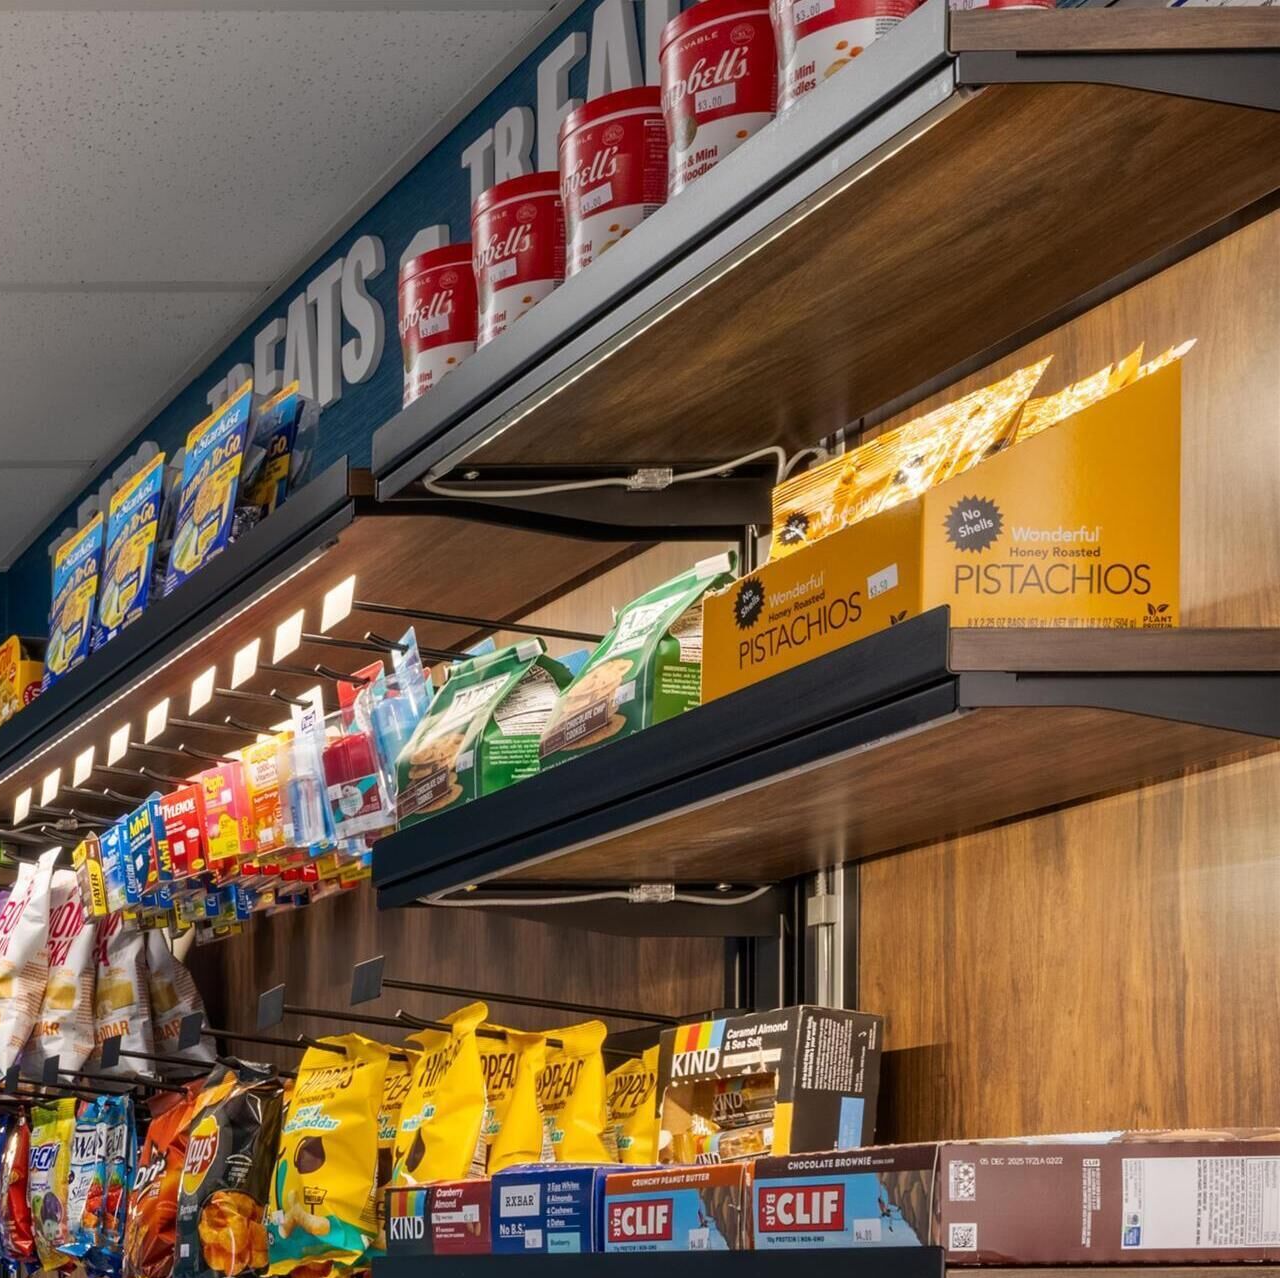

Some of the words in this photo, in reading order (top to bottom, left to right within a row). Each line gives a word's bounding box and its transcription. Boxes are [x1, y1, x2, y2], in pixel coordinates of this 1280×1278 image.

[795, 4, 821, 23] $3.00
[662, 46, 750, 116] mpbell's
[794, 61, 816, 81] Mini
[792, 78, 817, 97] dles
[462, 0, 672, 200] TREA
[697, 95, 722, 110] $3.00
[695, 146, 718, 164] Mini
[560, 146, 619, 201] mpbell's
[473, 223, 532, 277] pbell's
[399, 289, 454, 338] pbell's
[962, 509, 981, 522] No
[958, 518, 994, 538] Shells
[1011, 526, 1100, 542] Wonderful
[1009, 547, 1049, 560] Honey
[1053, 547, 1101, 558] Roasted
[769, 572, 824, 608] Wonderful
[954, 564, 1151, 594] PISTACHIOS
[740, 596, 761, 618] Shells
[742, 590, 753, 603] No
[768, 606, 791, 624] Honey
[794, 591, 825, 611] Roasted
[740, 592, 862, 669] PISTACHIOS
[163, 798, 196, 821] TYLENOL
[129, 809, 149, 839] Advil
[158, 840, 171, 871] Advil
[90, 873, 102, 907] BAYER
[727, 1027, 757, 1039] Caramel
[758, 1020, 788, 1035] Almond
[725, 1042, 731, 1051] &
[732, 1039, 746, 1050] Sea
[747, 1036, 762, 1048] Salt
[671, 1049, 720, 1078] KIND
[788, 1159, 833, 1170] CHOCOLATE
[835, 1156, 871, 1167] BROWNIE
[632, 1177, 660, 1187] CRUNCHY
[661, 1175, 685, 1184] PEANUT
[685, 1173, 710, 1182] BUTTER
[434, 1200, 457, 1208] Almond
[436, 1188, 463, 1198] Cranberry
[505, 1195, 534, 1207] RXBAR
[766, 1194, 775, 1226] BAR
[777, 1190, 838, 1225] CLIF
[390, 1217, 424, 1240] KIND
[500, 1224, 510, 1234] No
[613, 1208, 621, 1237] BAR
[622, 1205, 669, 1236] CLIF
